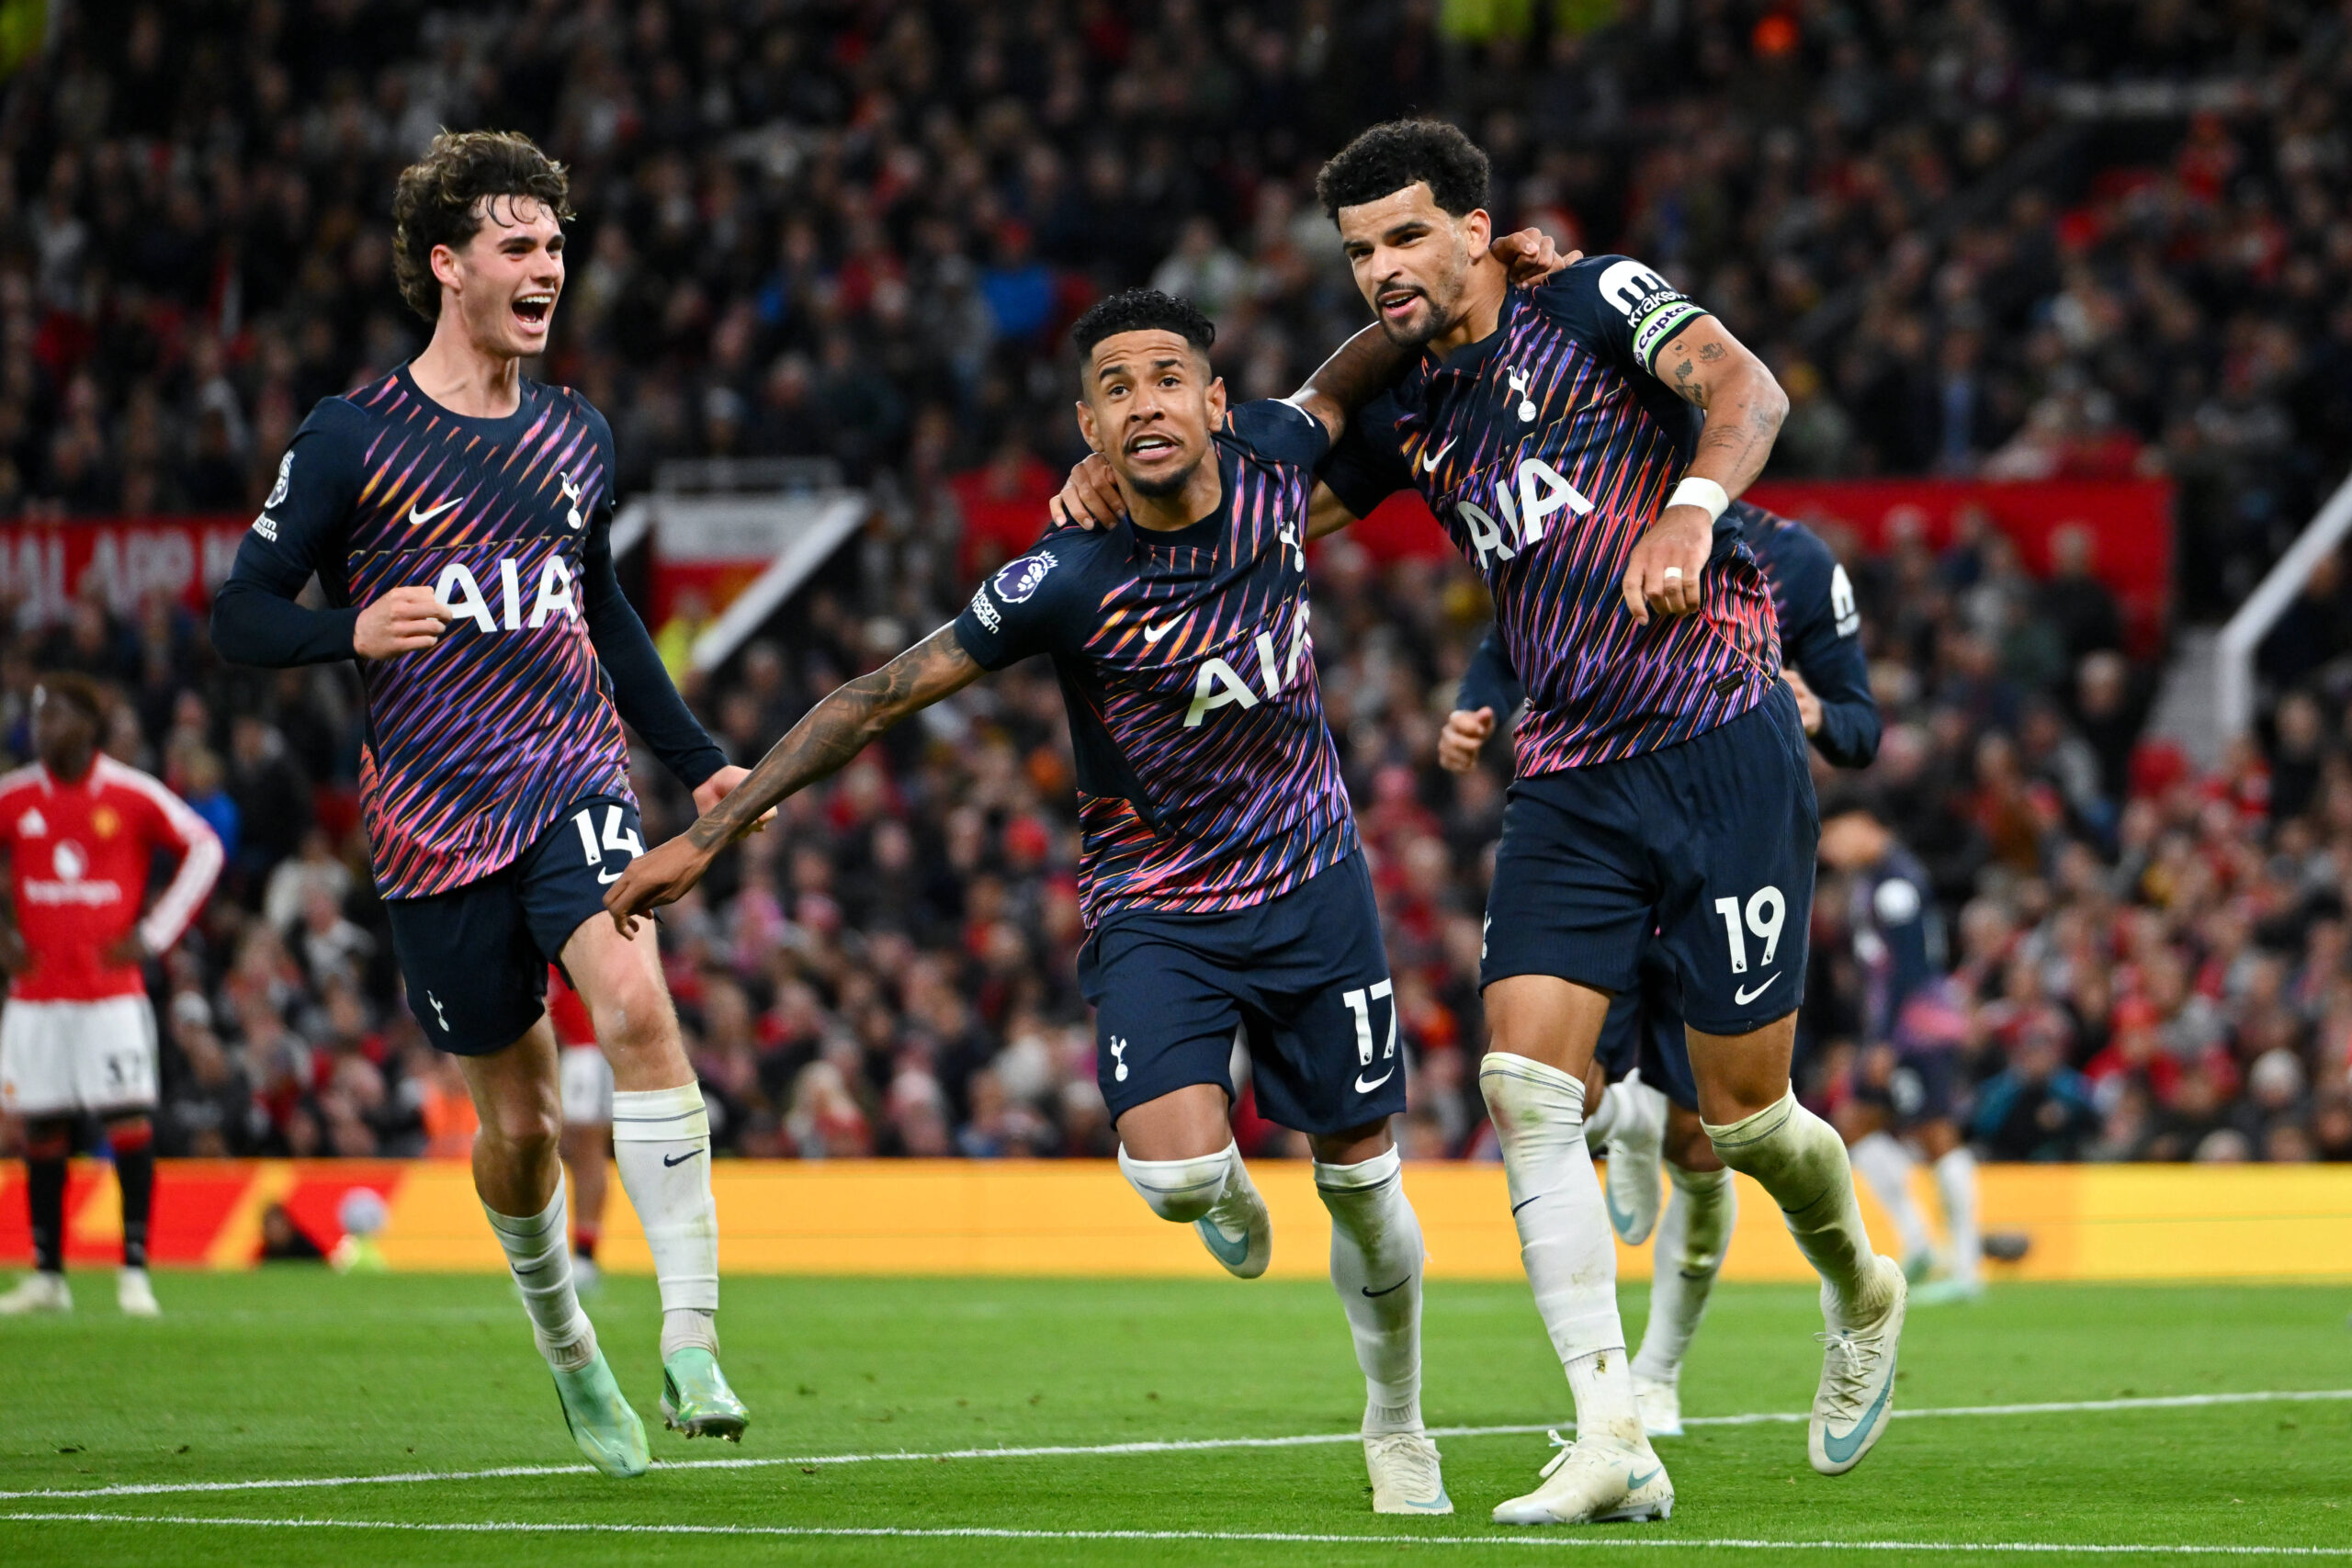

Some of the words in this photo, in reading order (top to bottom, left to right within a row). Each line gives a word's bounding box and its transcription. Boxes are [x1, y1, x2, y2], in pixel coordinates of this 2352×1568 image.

[1627, 290, 1688, 328] kraken
[1638, 304, 1693, 350] Capta
[1457, 457, 1595, 570] AIA
[425, 554, 578, 633] AIA
[570, 804, 645, 866] 14
[1714, 886, 1786, 974] 19
[1342, 976, 1396, 1066] 17
